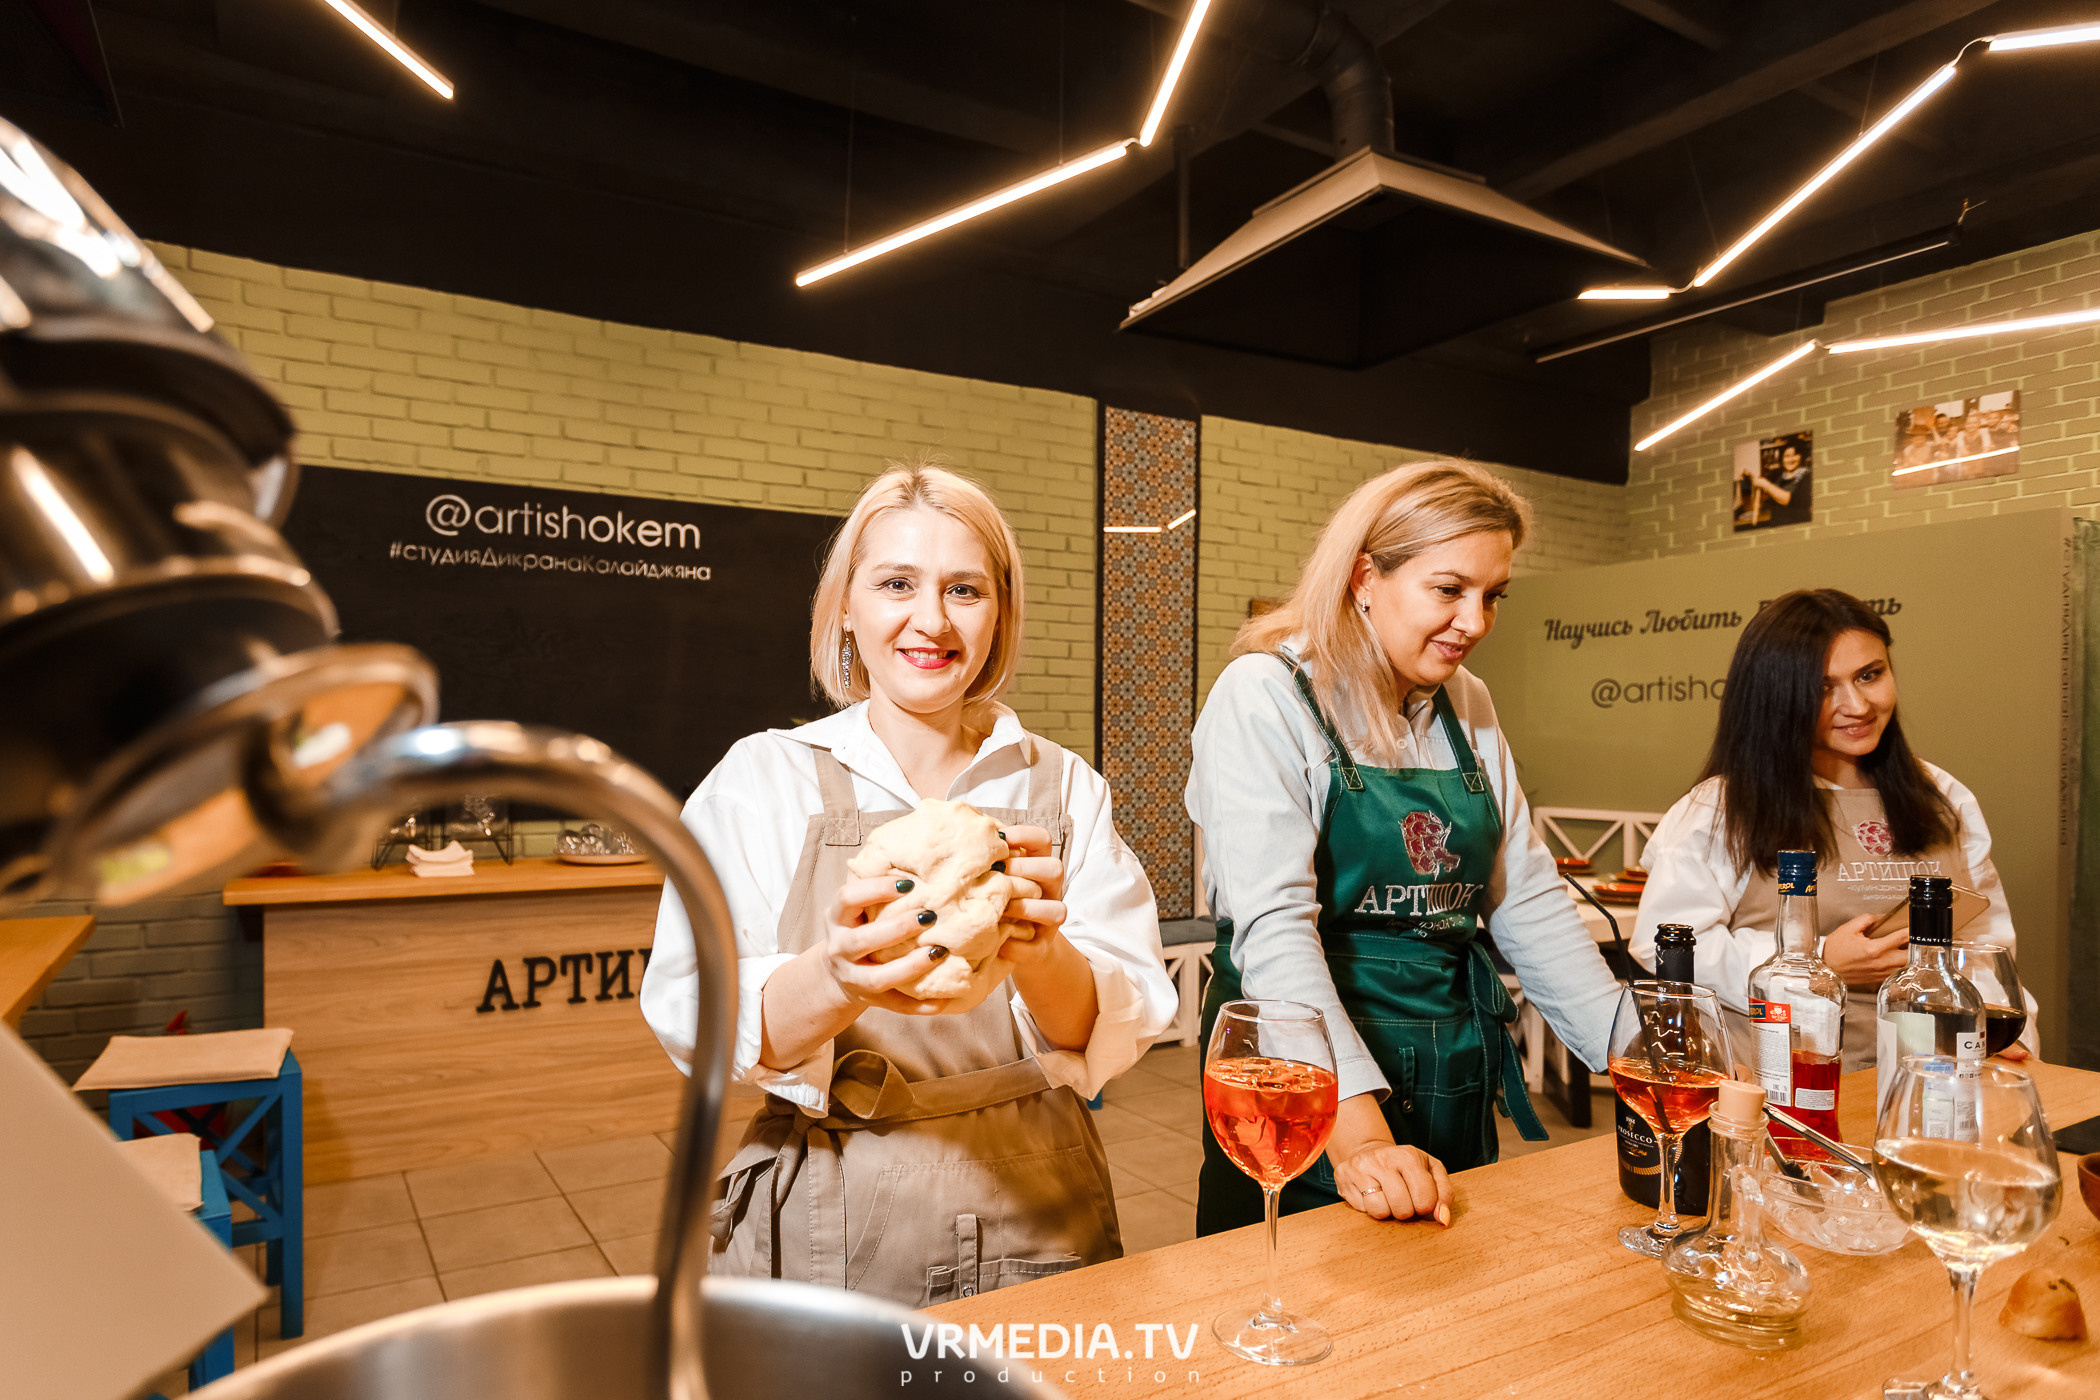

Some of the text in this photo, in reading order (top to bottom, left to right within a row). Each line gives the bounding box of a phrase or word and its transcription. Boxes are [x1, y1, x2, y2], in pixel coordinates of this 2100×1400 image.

[425, 494, 701, 549] @artishokem
[1545, 608, 1742, 650] Научись Любить
[1836, 860, 1943, 882] АРТИШОК
[1354, 882, 1484, 917] АРТИШОК
[1617, 1124, 1653, 1144] PROSECCO
